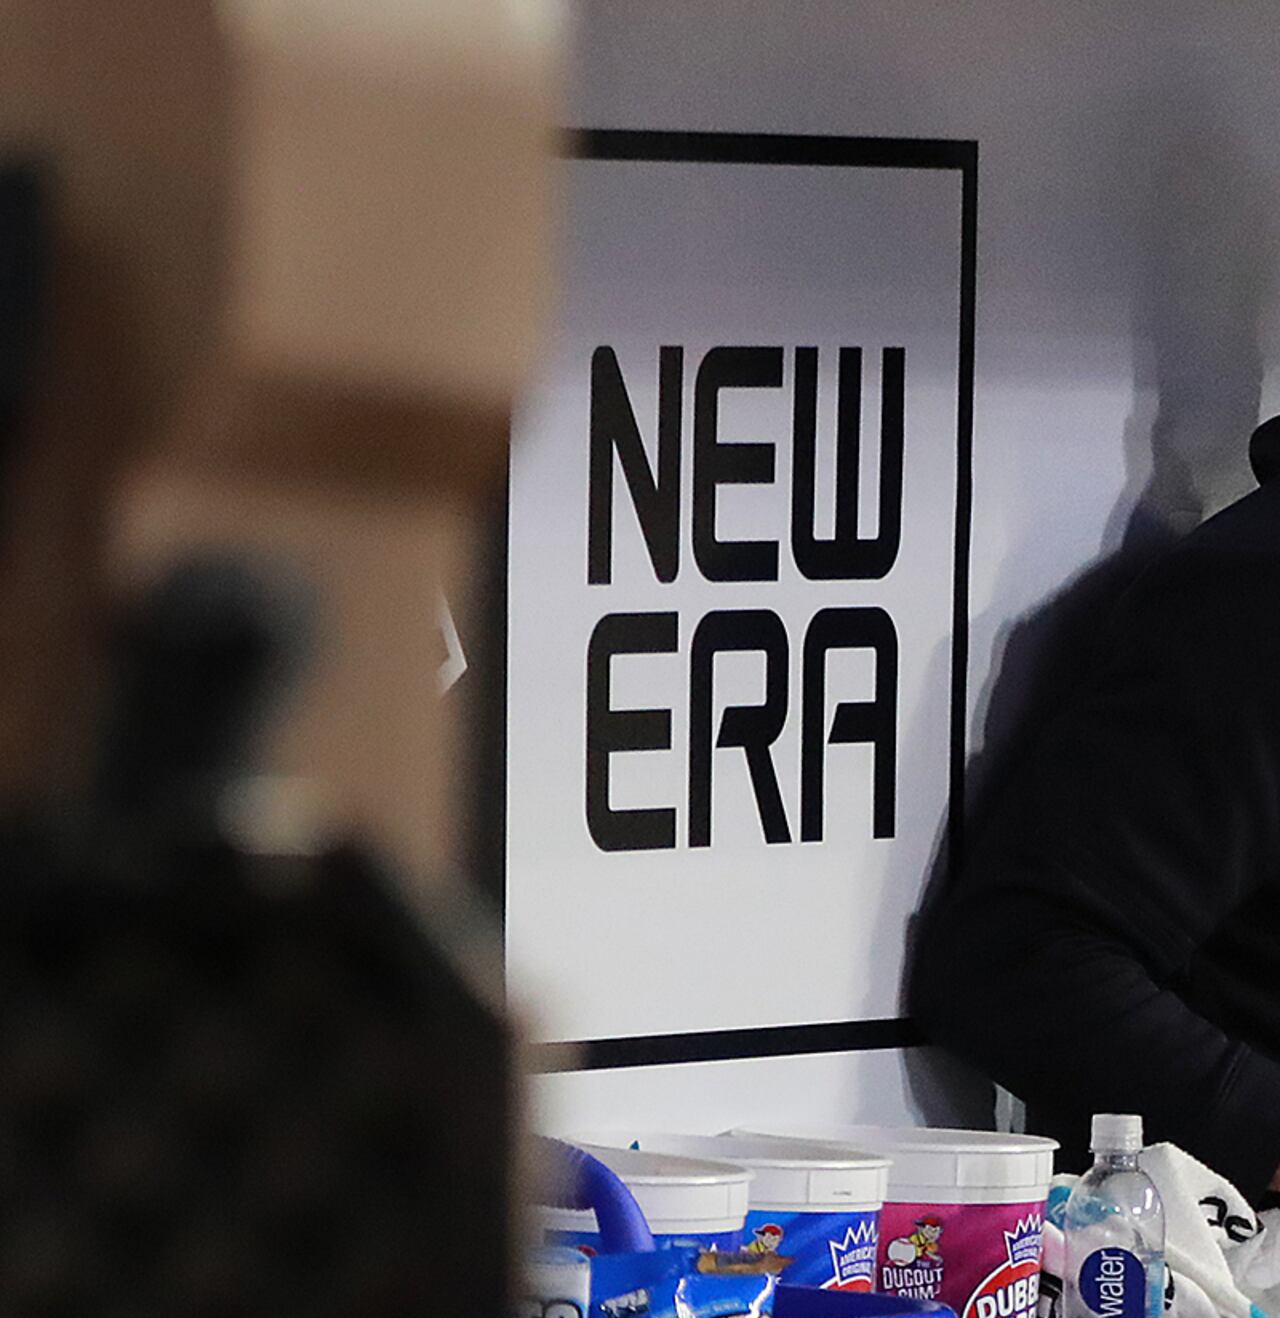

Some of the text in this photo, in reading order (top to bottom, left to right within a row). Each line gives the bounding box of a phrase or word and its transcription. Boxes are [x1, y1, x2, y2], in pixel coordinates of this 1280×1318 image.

[587, 345, 906, 586] NEW
[586, 606, 899, 853] ERA
[882, 1266, 944, 1290] DUGOUT
